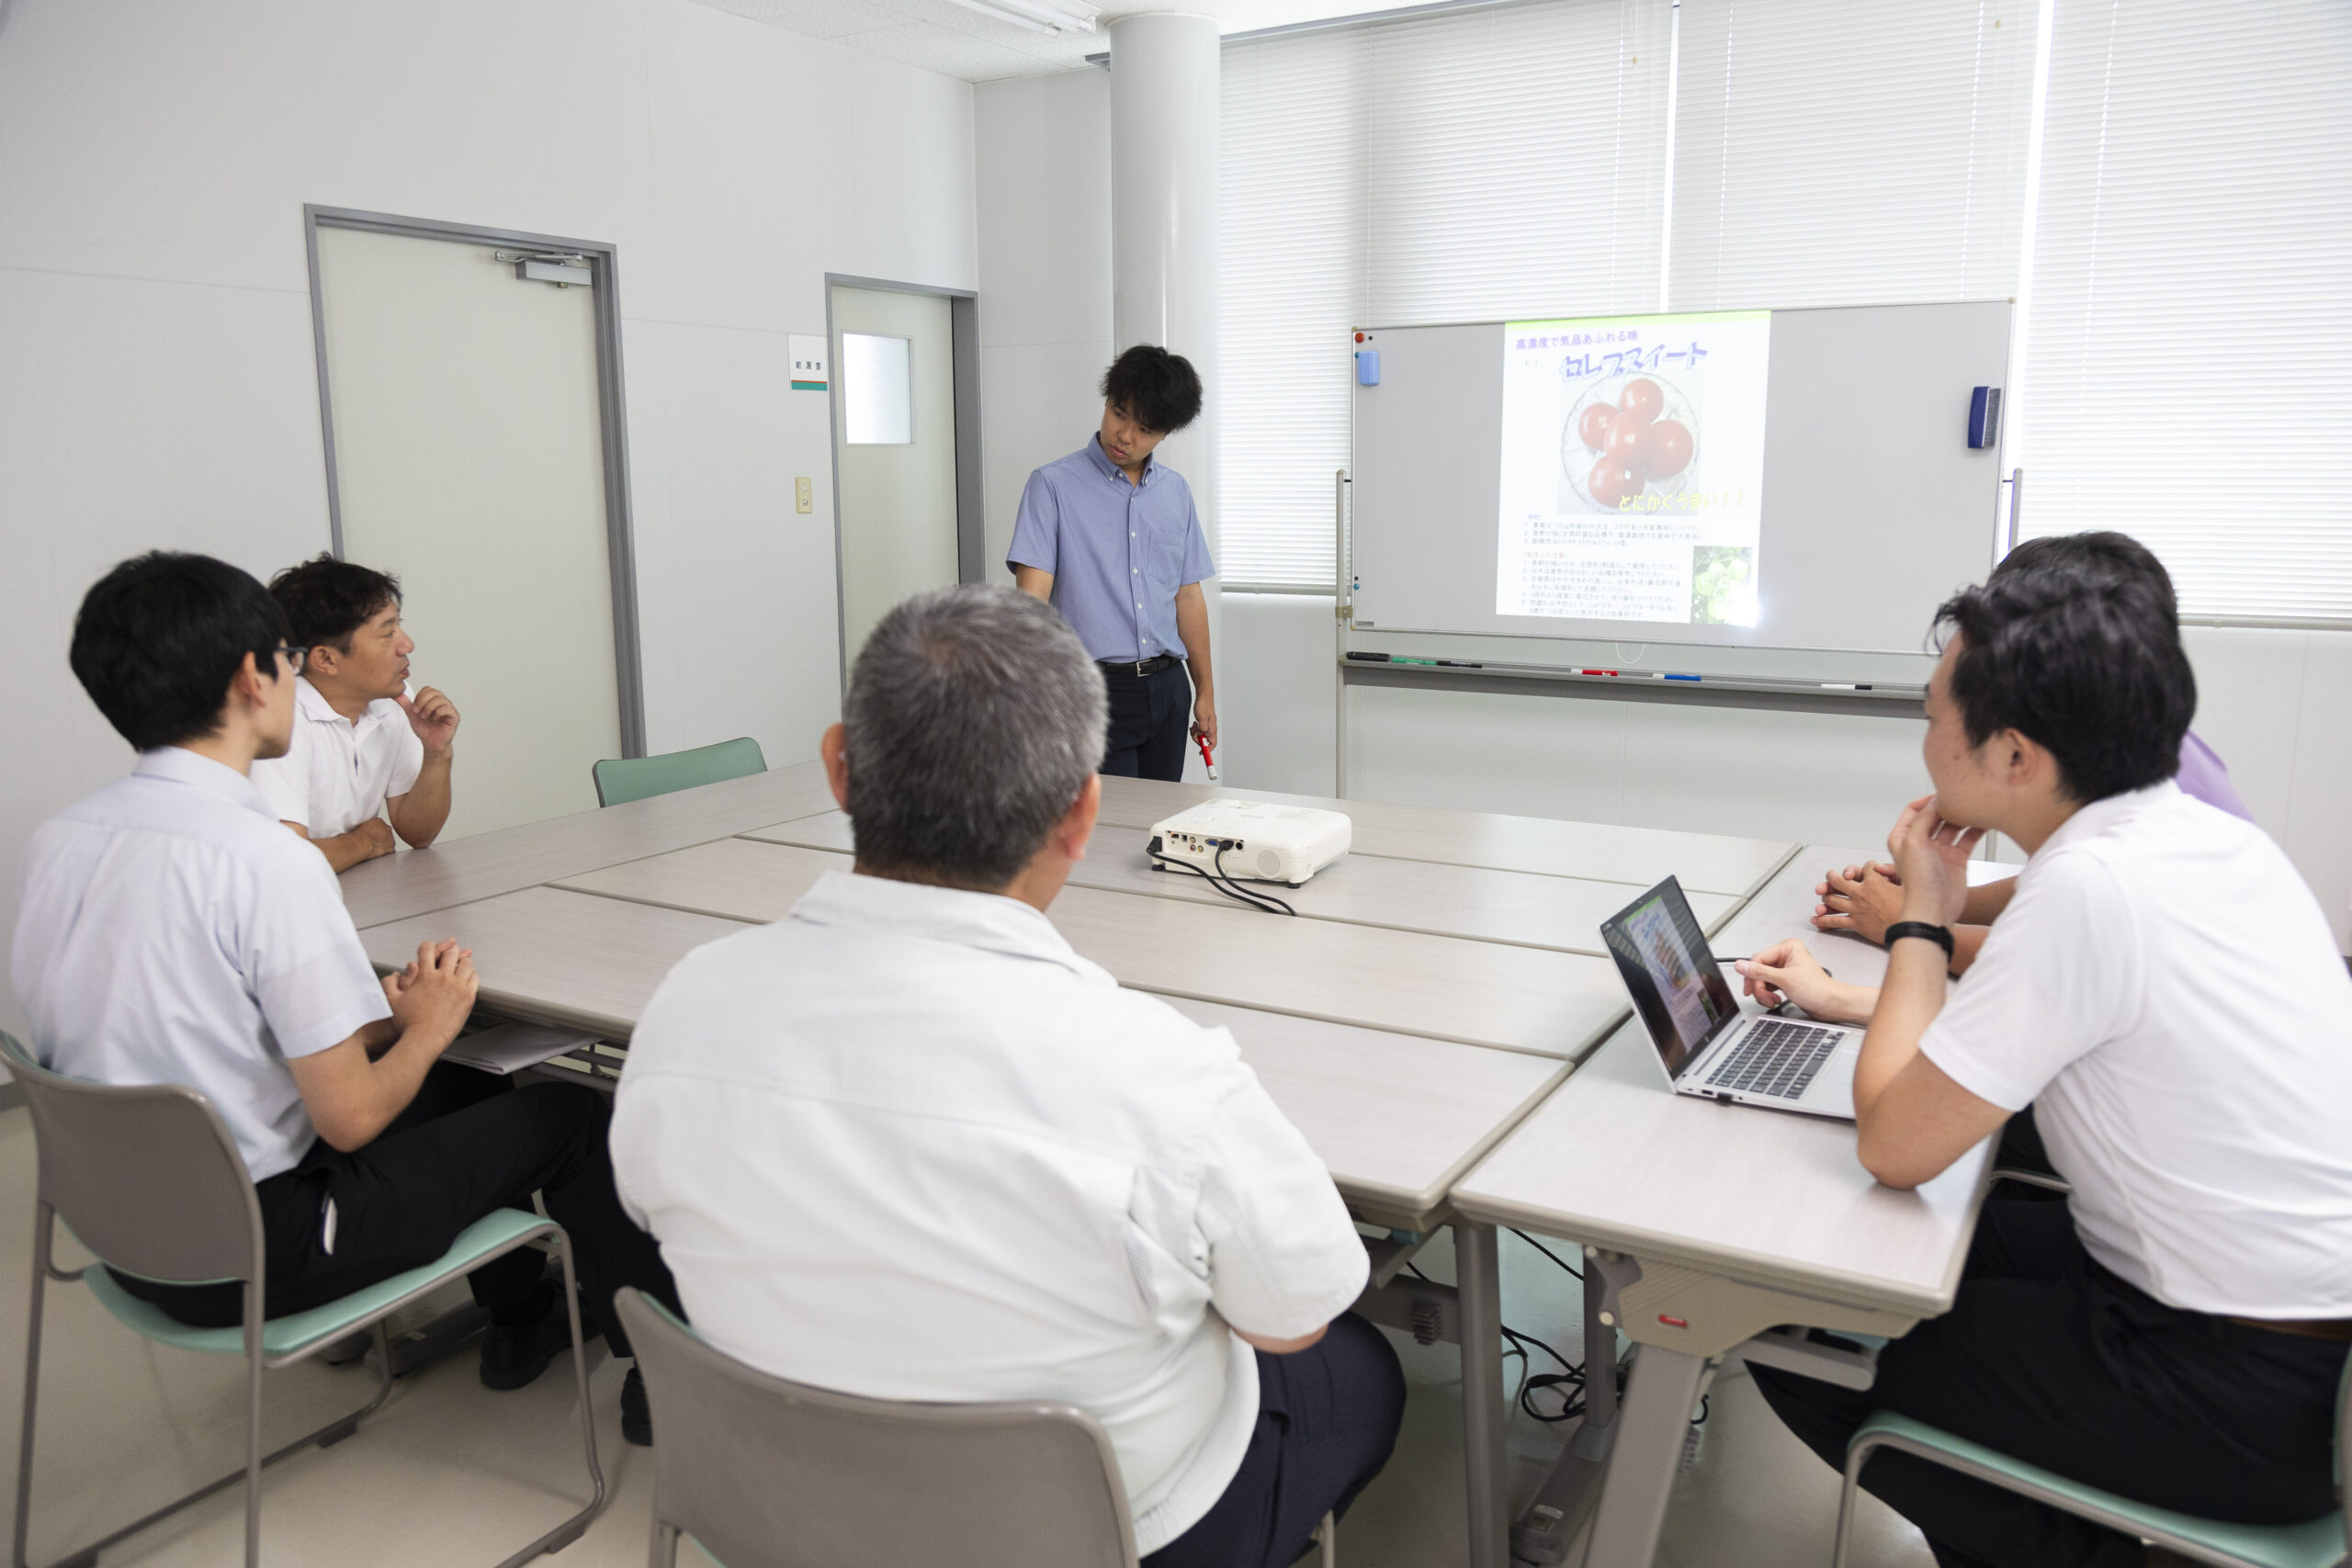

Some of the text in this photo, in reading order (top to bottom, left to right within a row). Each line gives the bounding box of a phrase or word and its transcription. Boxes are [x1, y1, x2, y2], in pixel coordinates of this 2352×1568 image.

[1516, 330, 1639, 351] 高濃度で気品あふれる味
[1560, 342, 1708, 381] セレブスイート
